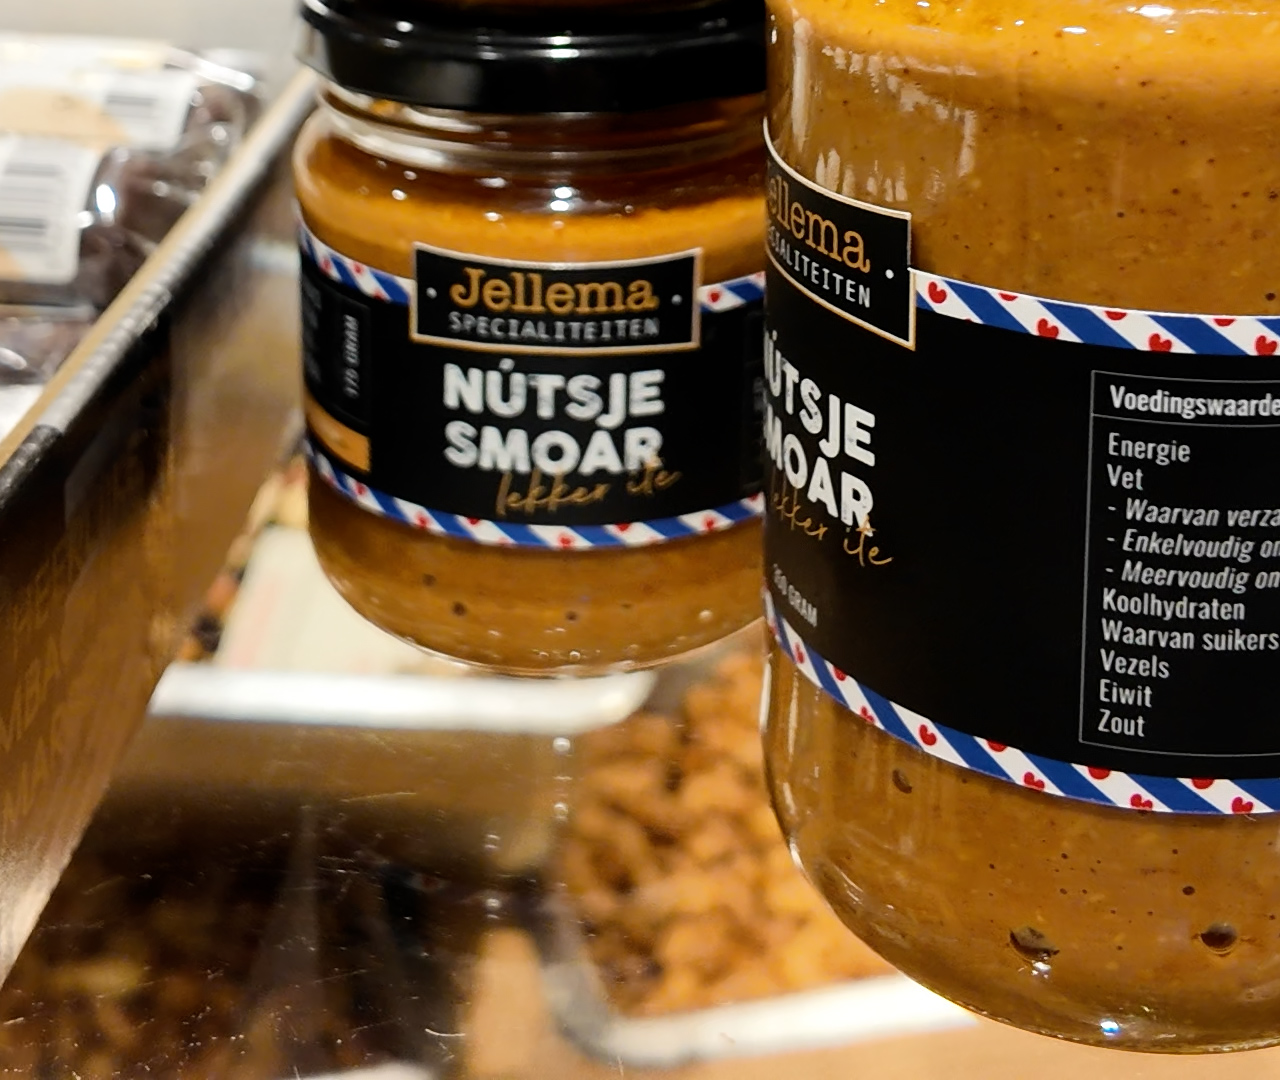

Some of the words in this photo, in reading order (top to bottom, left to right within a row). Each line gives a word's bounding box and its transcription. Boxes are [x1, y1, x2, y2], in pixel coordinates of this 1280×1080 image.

[768, 175, 870, 274] ellema
[449, 267, 660, 316] Jellema
[448, 310, 660, 342] SPECIALITEITEN
[442, 358, 665, 430] NÚTSJE
[443, 420, 663, 476] SMOAR
[1108, 433, 1191, 465] Energie
[764, 397, 874, 537] MOAR
[1107, 464, 1144, 491] Vet
[495, 466, 610, 517] lekker
[1126, 497, 1220, 526] Waarvan
[1123, 529, 1254, 562] Enkelvoudig
[1121, 561, 1248, 594] Meervoudig
[1102, 588, 1246, 621] Koolhydraten
[1101, 618, 1194, 649] Waarvan
[1202, 628, 1280, 650] suikers
[1100, 649, 1170, 679] Vezels
[1099, 679, 1153, 708] Eiwit
[1098, 710, 1145, 737] Zout
